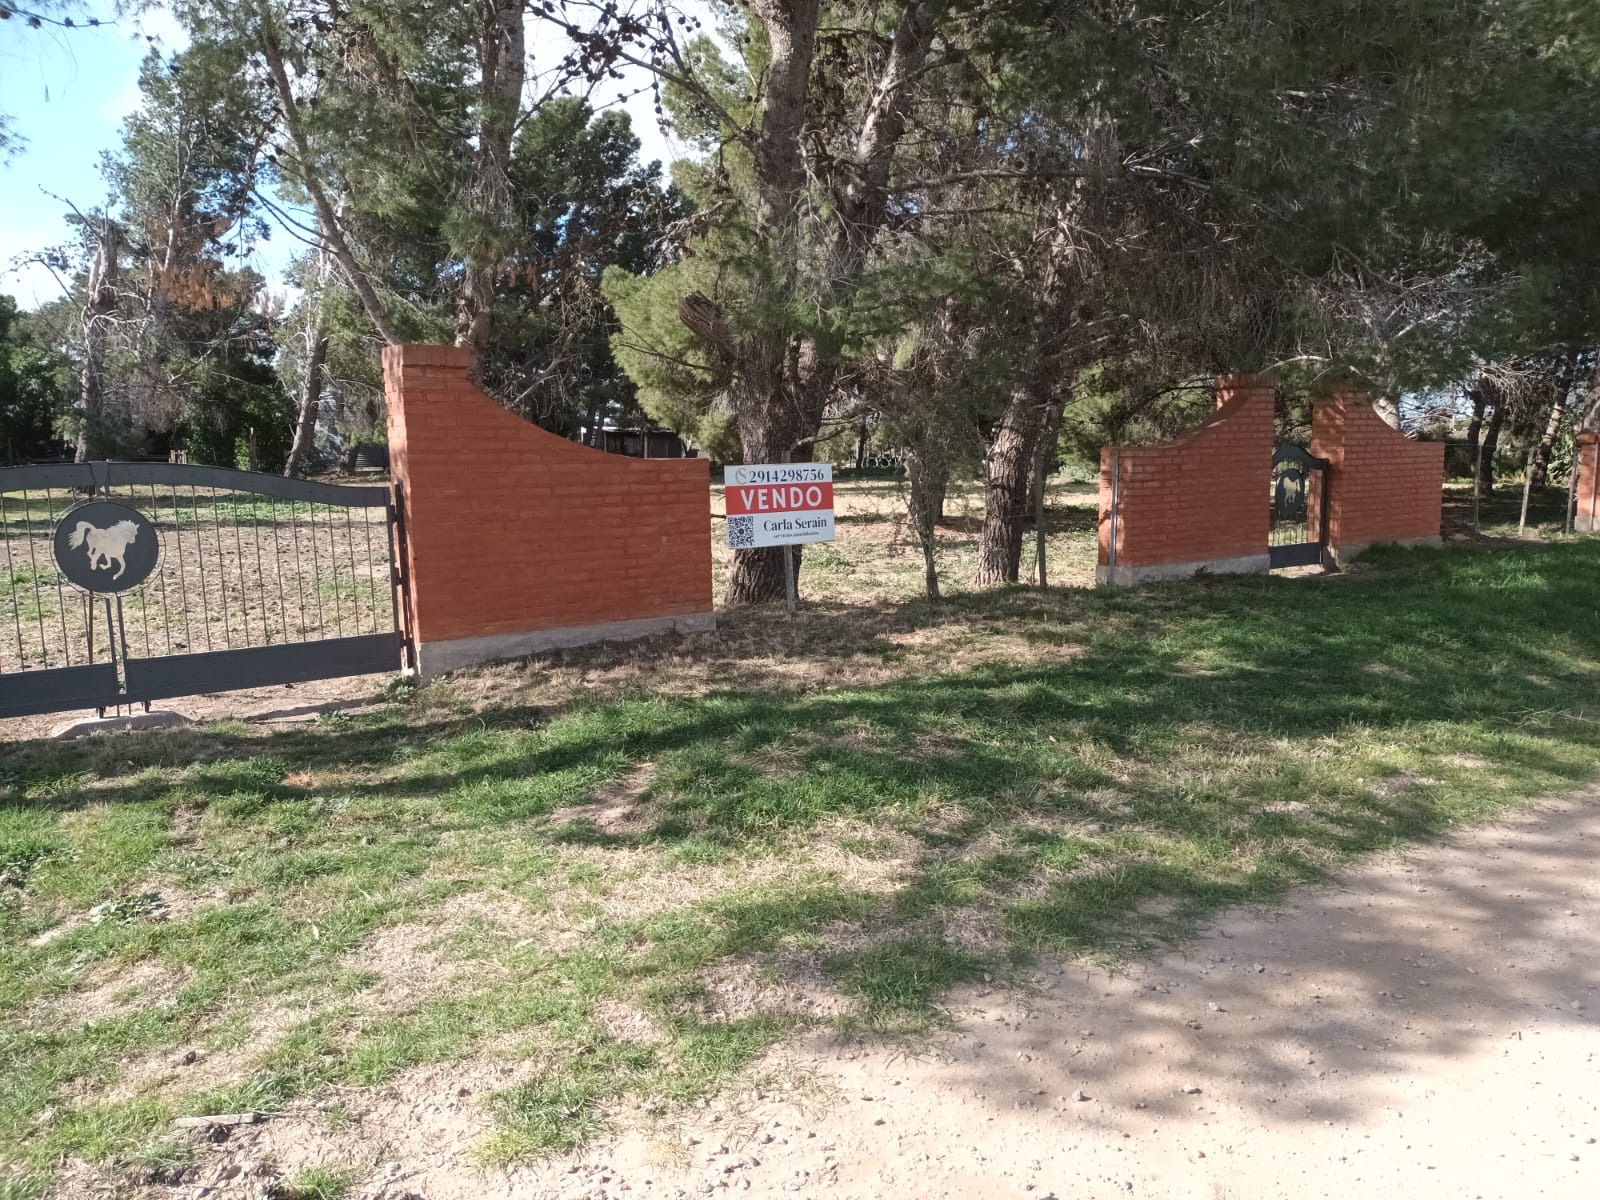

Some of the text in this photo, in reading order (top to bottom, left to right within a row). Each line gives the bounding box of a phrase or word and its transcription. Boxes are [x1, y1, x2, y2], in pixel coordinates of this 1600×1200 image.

[749, 469, 824, 483] 2914298756
[740, 486, 822, 510] VENDO
[763, 517, 827, 532] Carla Serain
